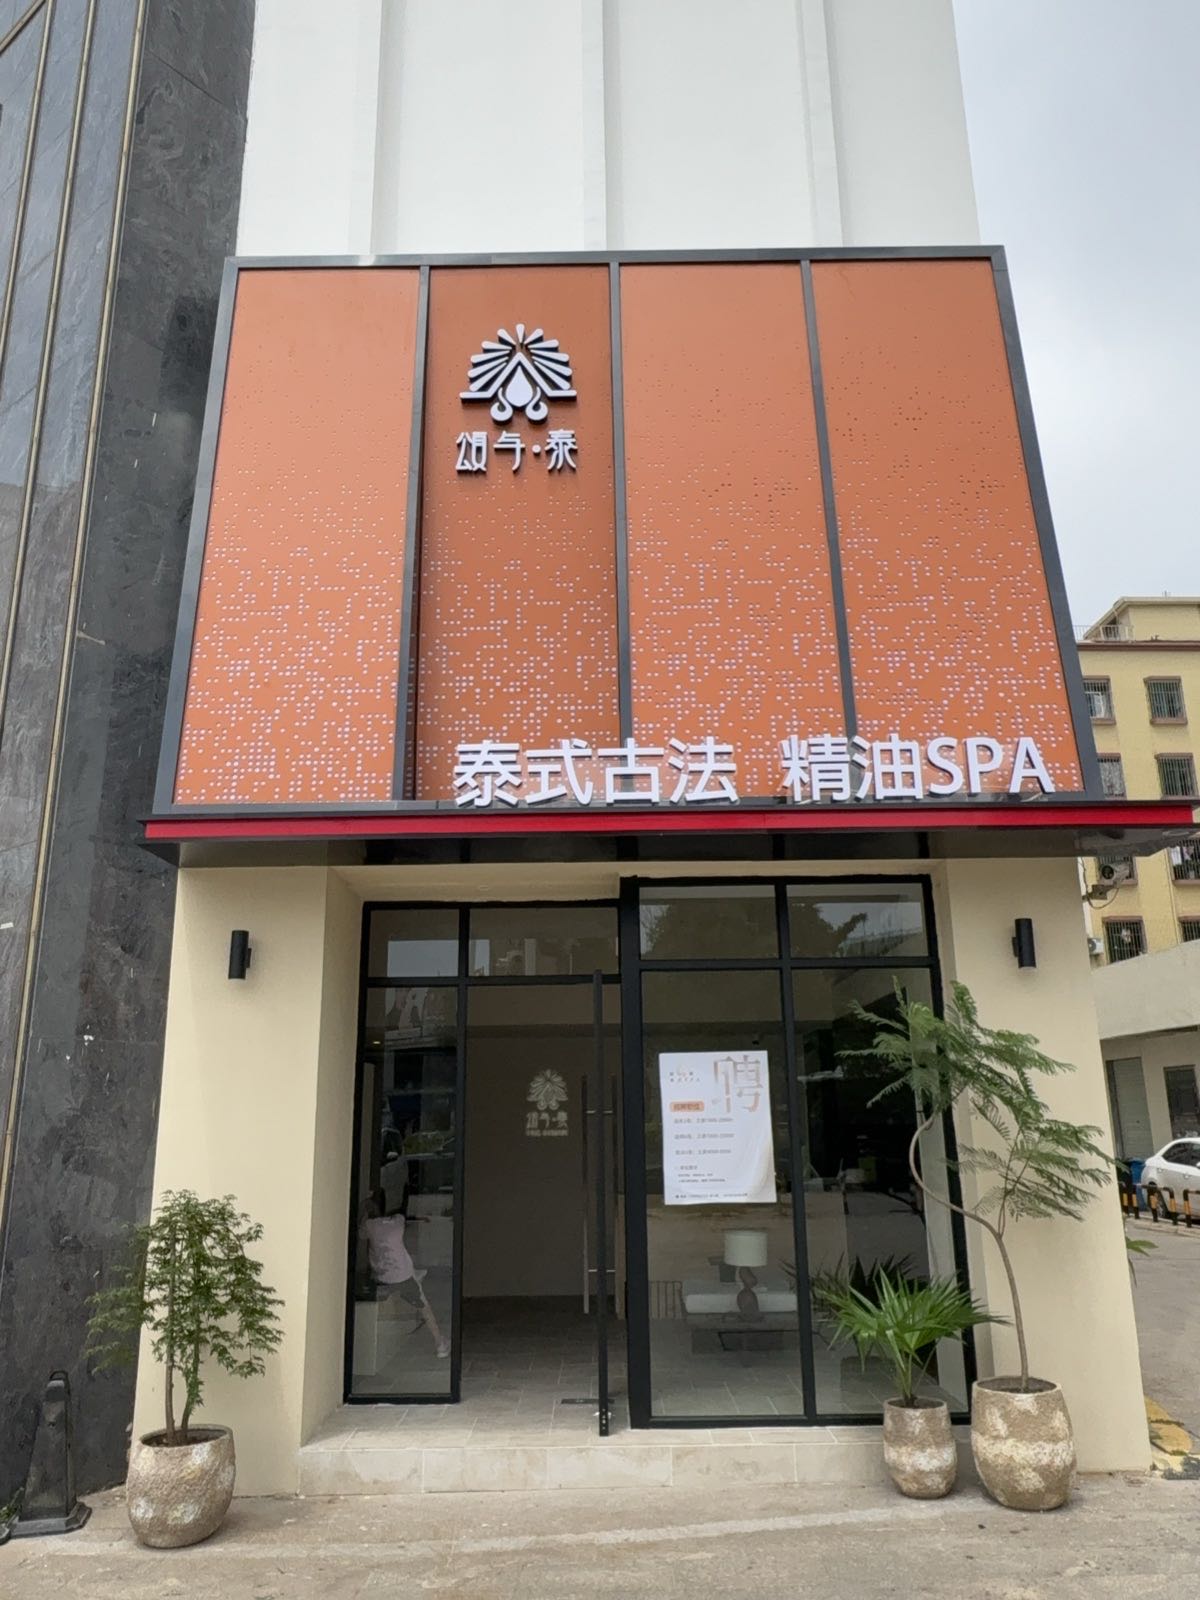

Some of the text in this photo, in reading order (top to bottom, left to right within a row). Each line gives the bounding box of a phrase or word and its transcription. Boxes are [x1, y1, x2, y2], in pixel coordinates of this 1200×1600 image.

[453, 733, 1055, 807] 泰式古法 精油SPA
